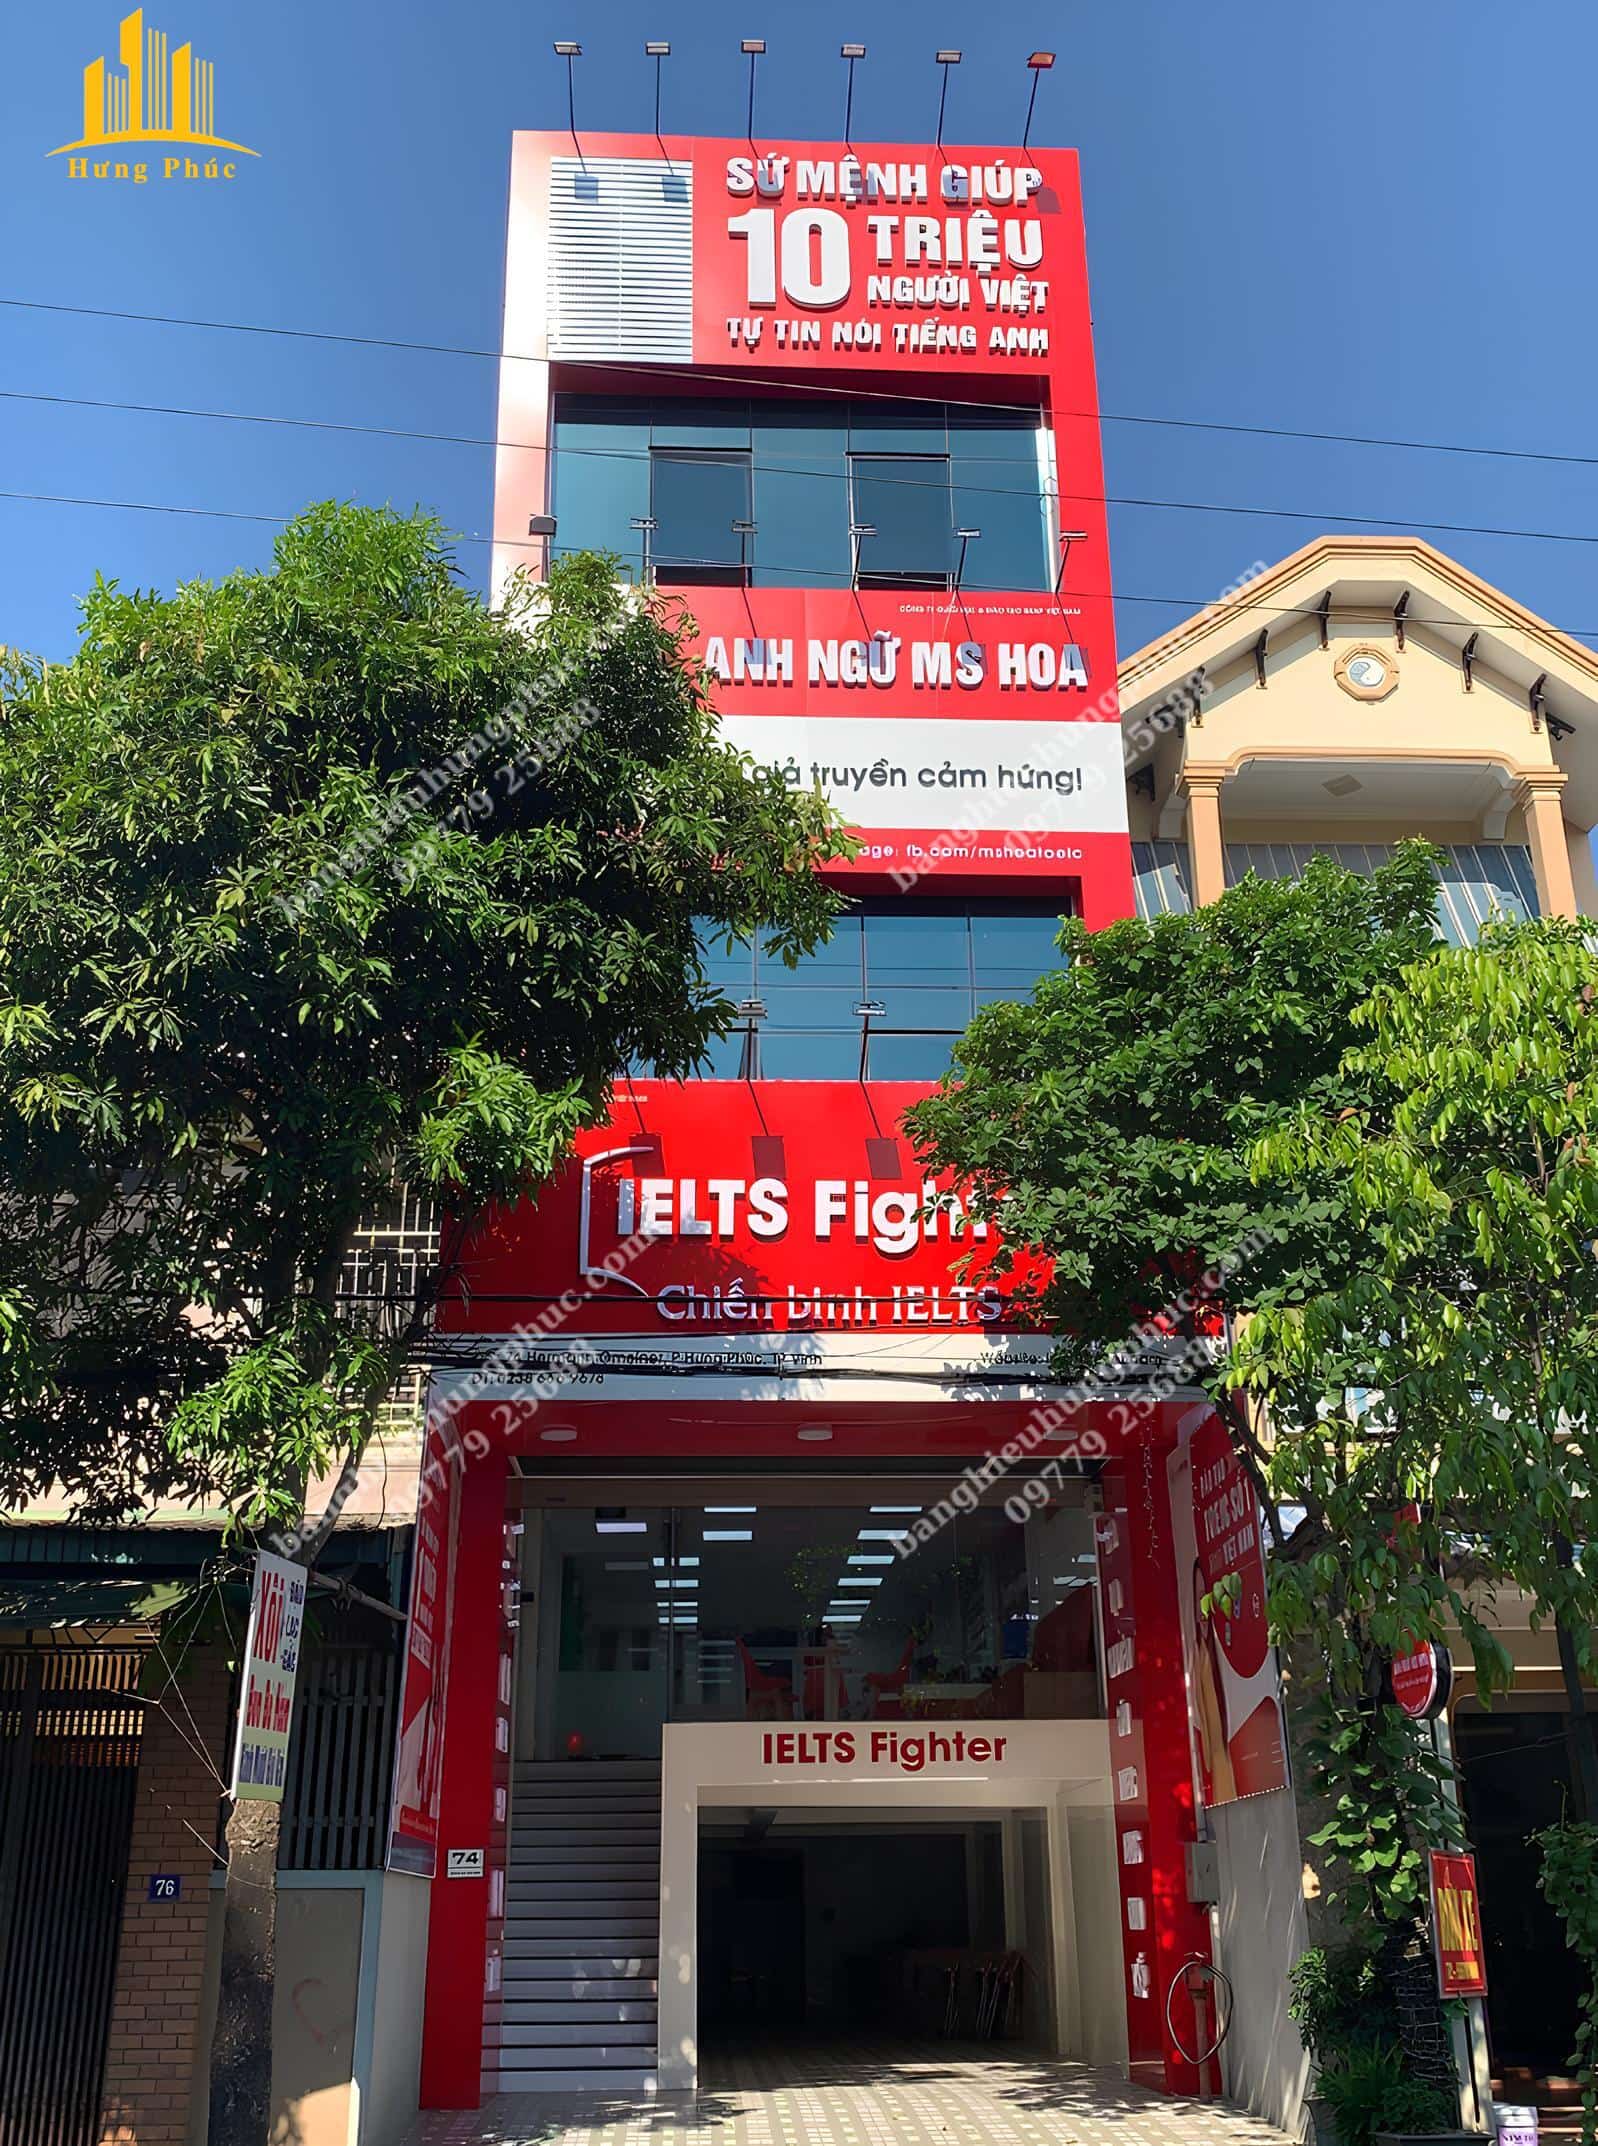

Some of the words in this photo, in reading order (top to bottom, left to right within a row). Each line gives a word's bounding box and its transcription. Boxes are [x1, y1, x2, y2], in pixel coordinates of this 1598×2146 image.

[726, 152, 791, 198] SỨ
[796, 153, 929, 208] MỆNH
[940, 158, 1044, 206] GIÚP
[727, 207, 852, 311] 10
[867, 209, 1044, 278] TRIỆU
[867, 271, 971, 312] NGƯỜI
[981, 274, 1049, 317] VIỆT
[726, 317, 764, 353] TỰ
[774, 319, 822, 351] TIN
[832, 318, 882, 352] NÓI
[892, 317, 977, 353] TIẾNG
[988, 327, 1049, 356] ANH
[705, 636, 793, 687] ANH
[808, 630, 901, 689] NGỮ
[911, 641, 987, 690] MS
[998, 642, 1089, 692] HOA
[811, 757, 907, 796] truyền
[918, 758, 987, 789] cảm
[998, 761, 1083, 796] hứng!
[617, 1177, 789, 1239] IELTS
[657, 1277, 773, 1321] Chiến
[788, 1284, 878, 1323] binh
[892, 1286, 1002, 1321] IELTS
[762, 1731, 857, 1766] IELTS
[870, 1730, 1008, 1772] Fighter
[452, 1851, 479, 1865] 74
[154, 1878, 175, 1897] 76
